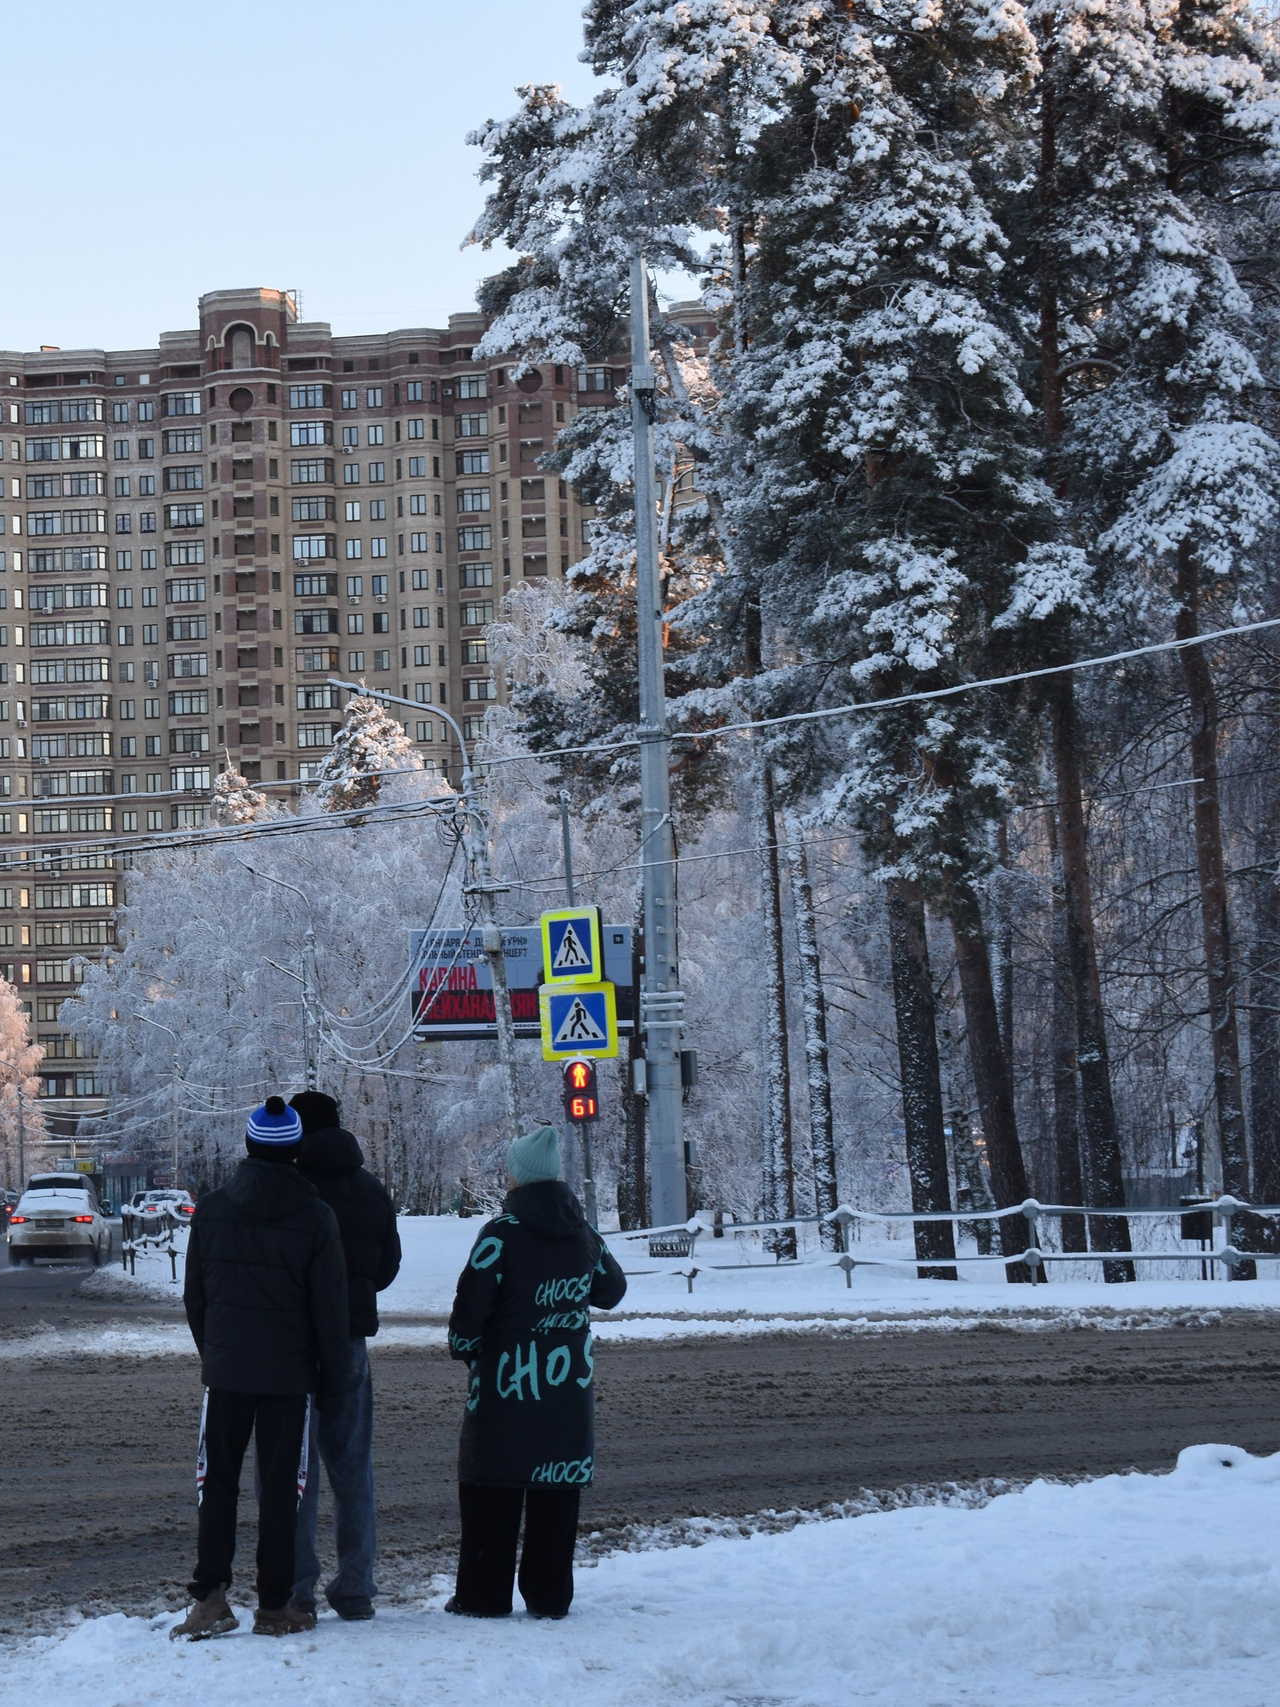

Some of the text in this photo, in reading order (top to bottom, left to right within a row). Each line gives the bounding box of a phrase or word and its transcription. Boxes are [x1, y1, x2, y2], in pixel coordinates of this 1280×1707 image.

[421, 949, 456, 959] ОЛЬНЫЙ
[419, 967, 478, 990] КАРИНА
[572, 1098, 595, 1116] 61
